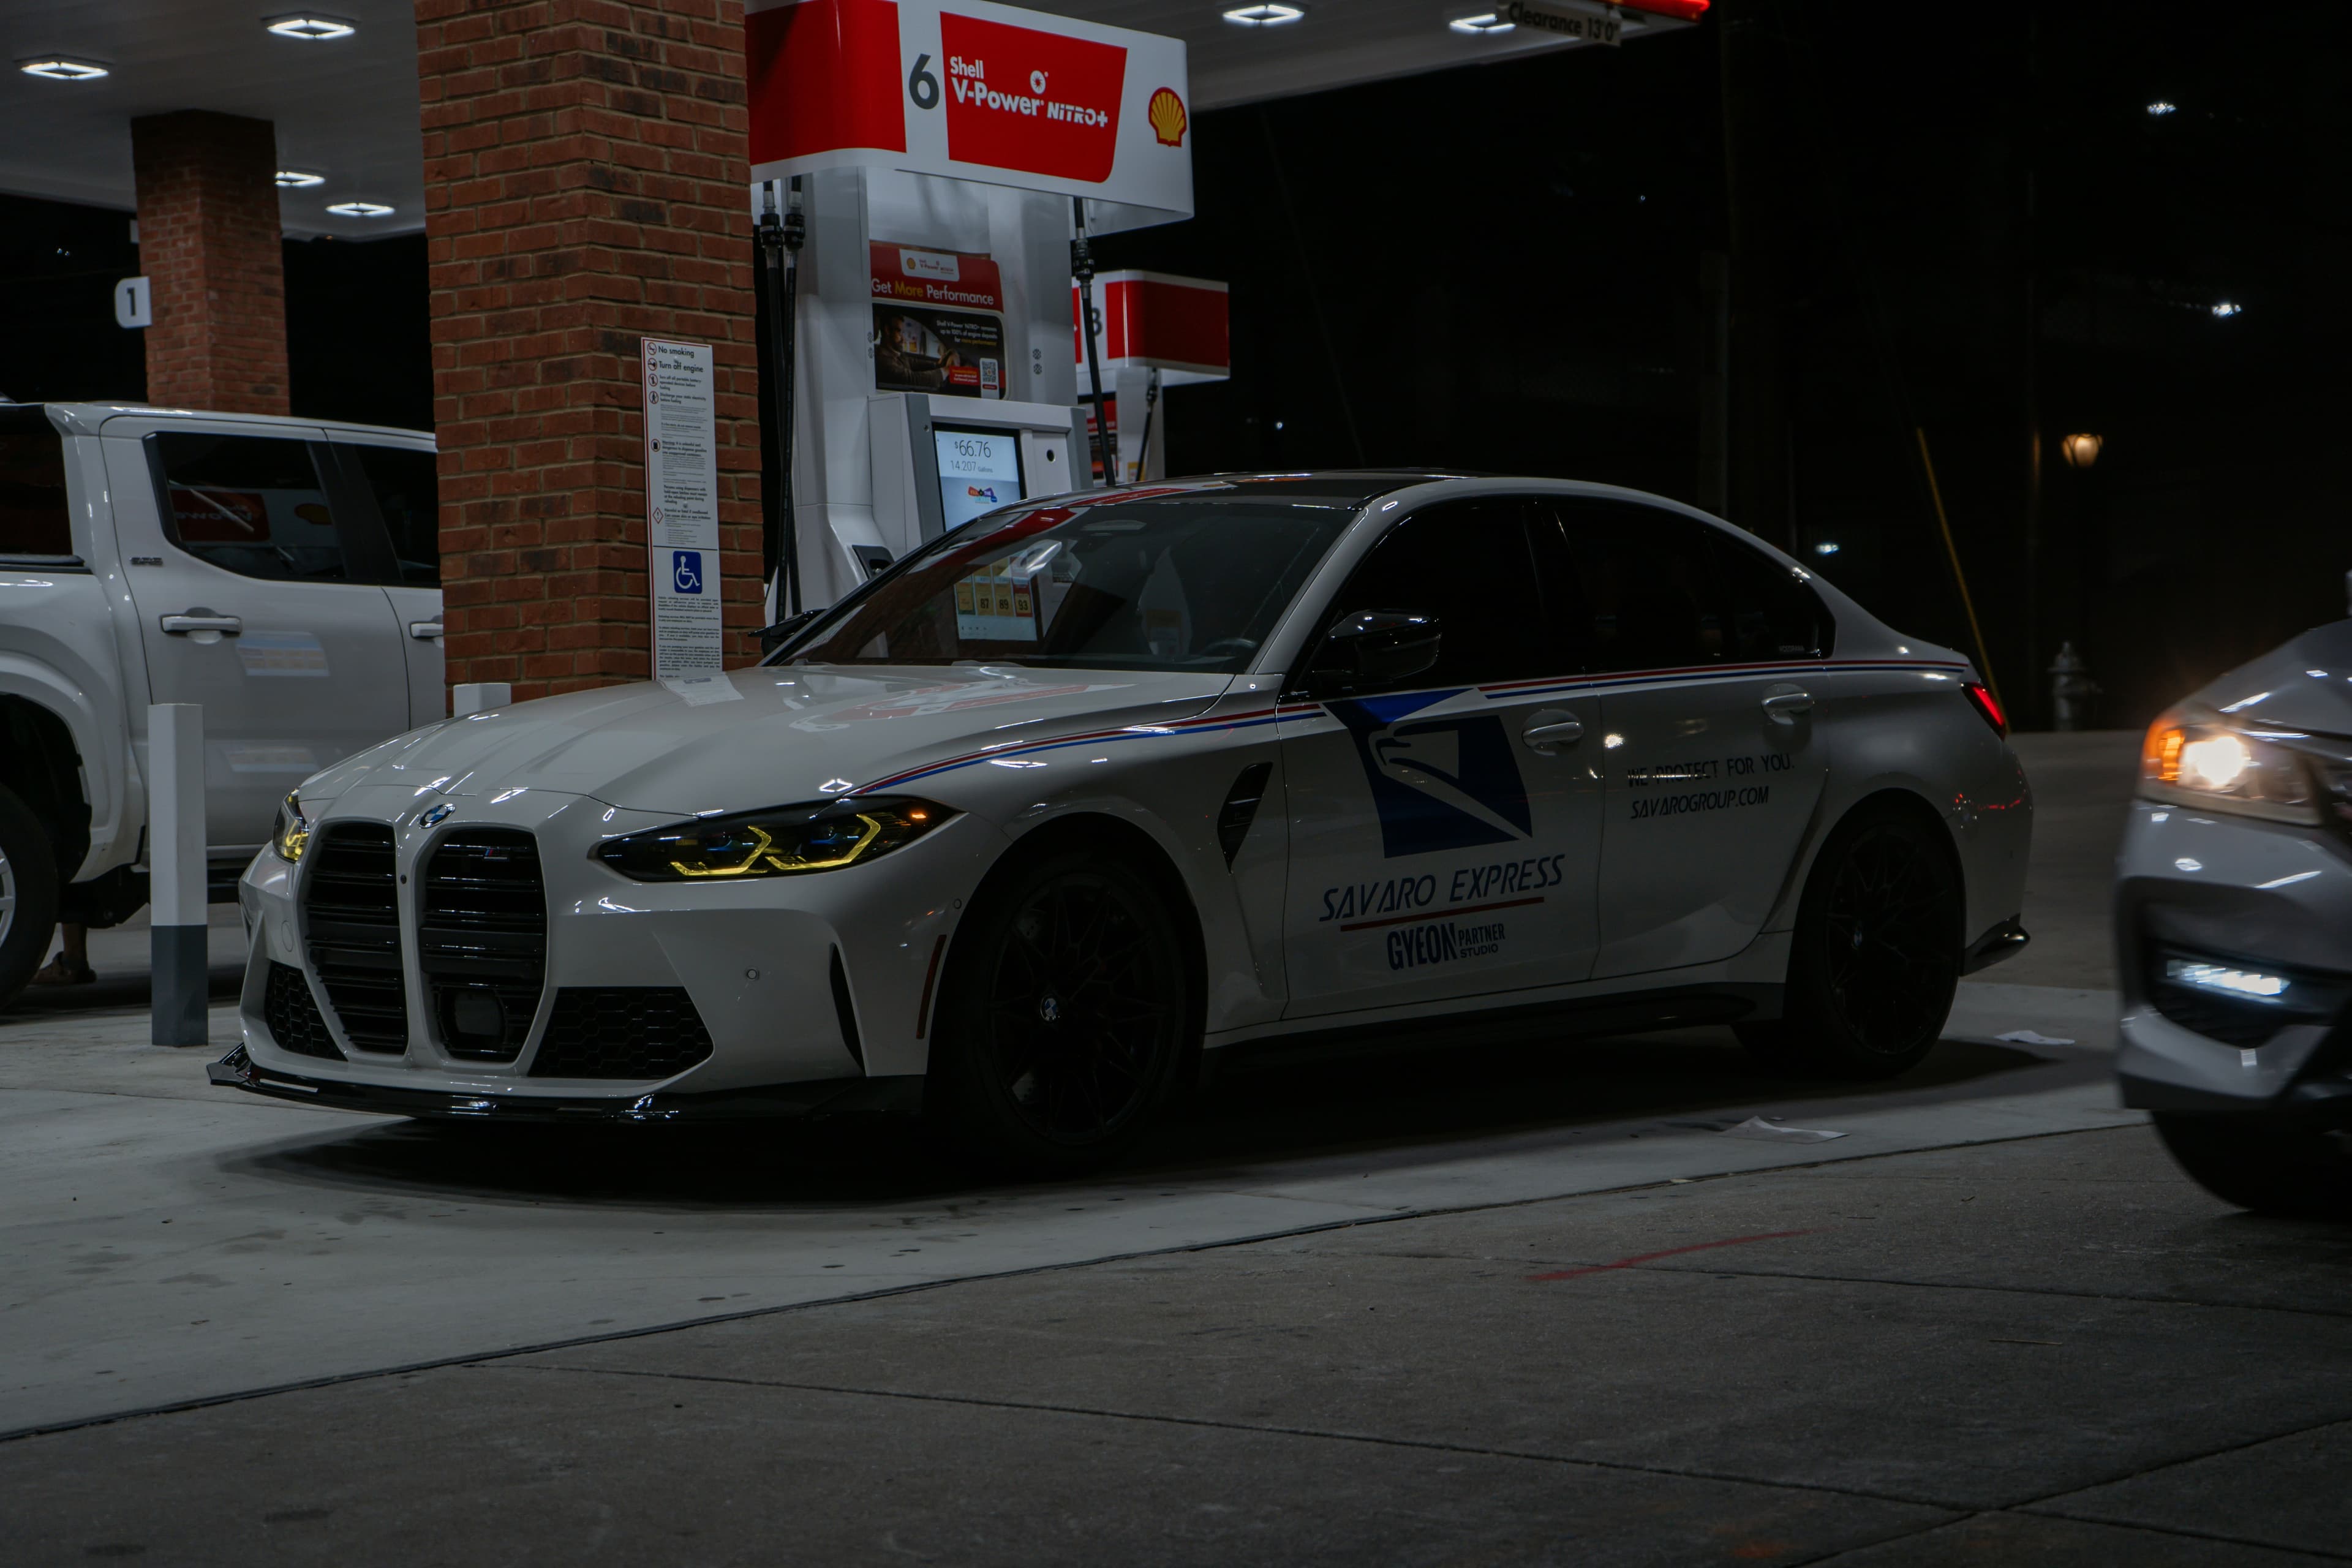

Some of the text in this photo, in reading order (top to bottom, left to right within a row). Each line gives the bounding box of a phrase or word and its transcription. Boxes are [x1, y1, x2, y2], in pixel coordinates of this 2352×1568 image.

[1508, 2, 1581, 34] Clearance
[909, 53, 940, 110] 6
[950, 56, 984, 80] Shell
[951, 77, 1041, 117] V-Power
[127, 287, 136, 315] 1
[872, 278, 994, 306] Get More Performance
[669, 347, 695, 358] smoking
[659, 361, 672, 369] Turn
[683, 364, 704, 374] engine
[955, 440, 991, 458] $66.76
[951, 460, 976, 472] 14.207
[981, 598, 1028, 610] 87 89 93
[1627, 753, 1795, 788] WE PROTECT FOR YOU.
[1631, 786, 1770, 819] SAVAROGROUP.COM
[1319, 854, 1566, 922] SAVARO EXPRESS
[1387, 922, 1457, 970] GYEON
[1458, 923, 1506, 946] PARTNER
[1460, 944, 1498, 959] STUDIO
